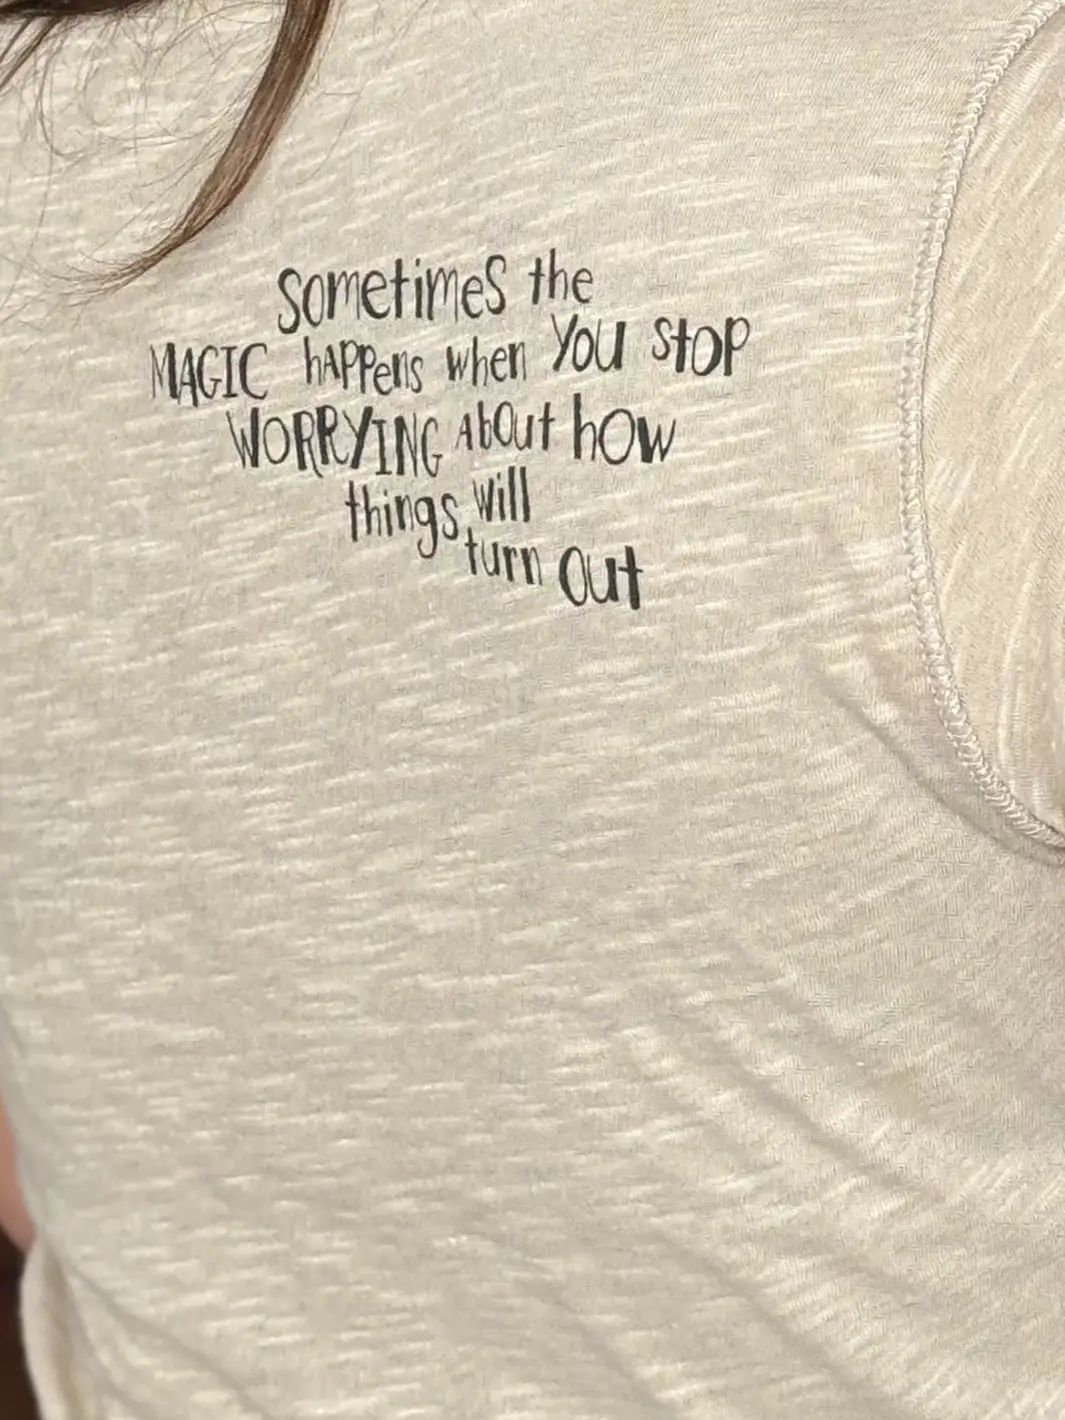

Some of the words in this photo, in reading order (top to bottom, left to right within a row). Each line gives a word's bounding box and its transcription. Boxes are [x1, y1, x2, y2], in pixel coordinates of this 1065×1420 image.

[527, 247, 594, 306] the
[149, 341, 269, 409] MAGIC
[445, 335, 528, 388] when
[225, 404, 444, 479] WORRYING
[344, 479, 460, 560] things
[472, 465, 531, 524] will
[464, 526, 544, 587] turn
